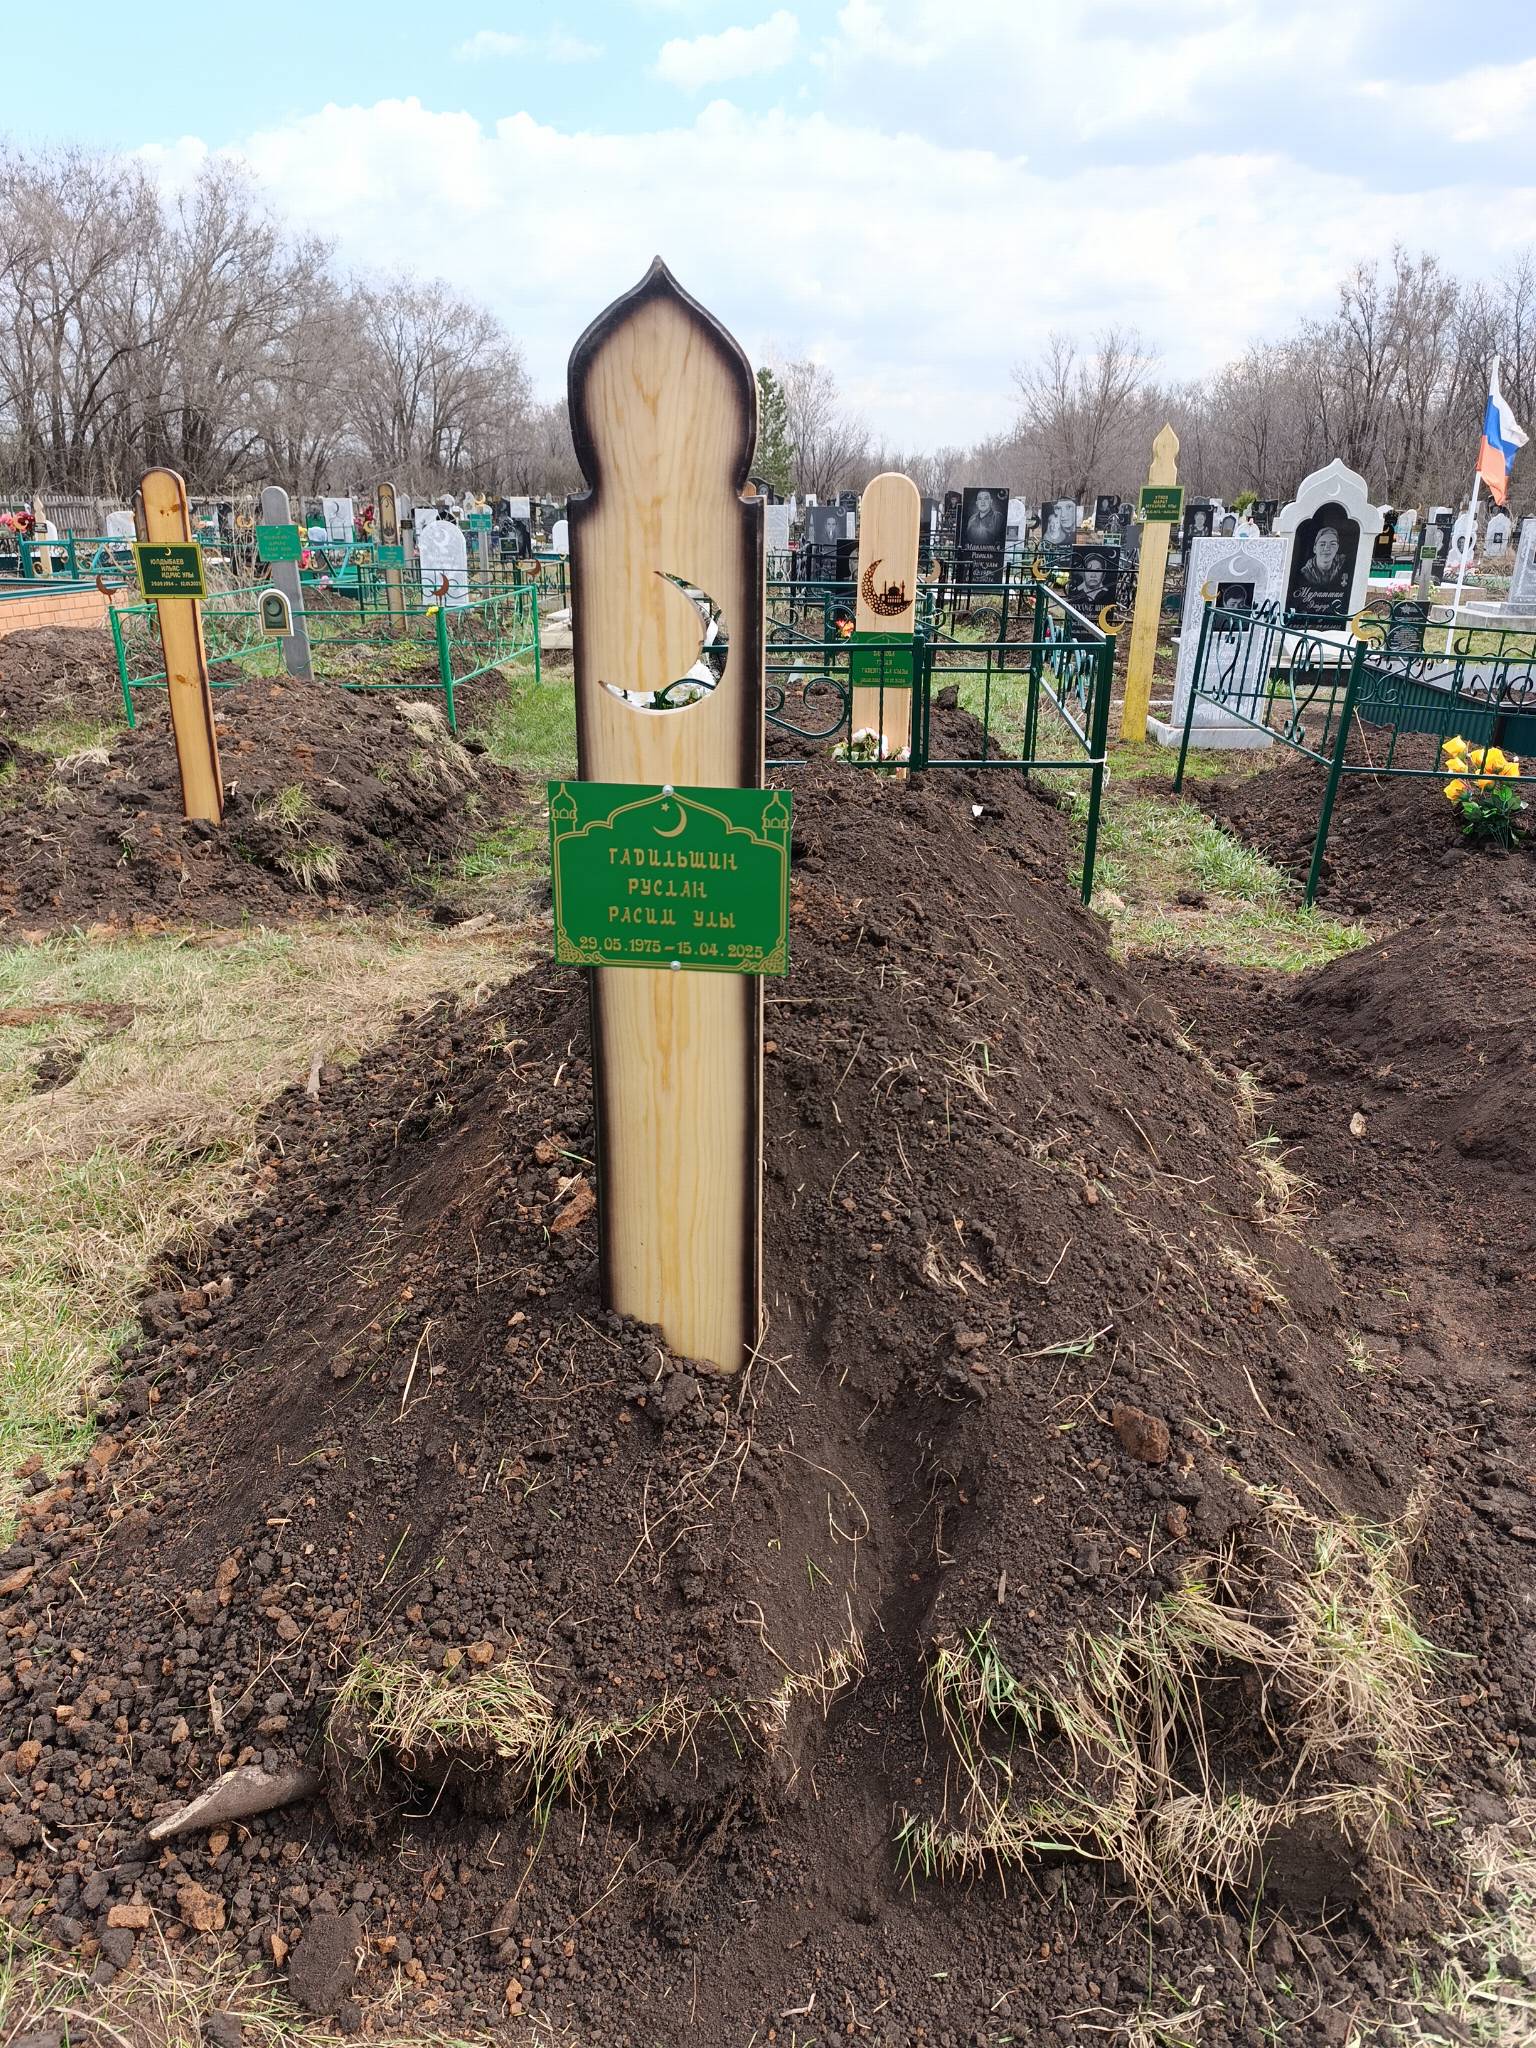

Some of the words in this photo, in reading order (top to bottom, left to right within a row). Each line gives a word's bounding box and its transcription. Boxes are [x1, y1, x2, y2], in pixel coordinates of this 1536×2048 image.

[628, 878, 707, 898] РУСЛАН
[608, 905, 677, 926] РАСИМ
[693, 910, 736, 928] УЛЫ
